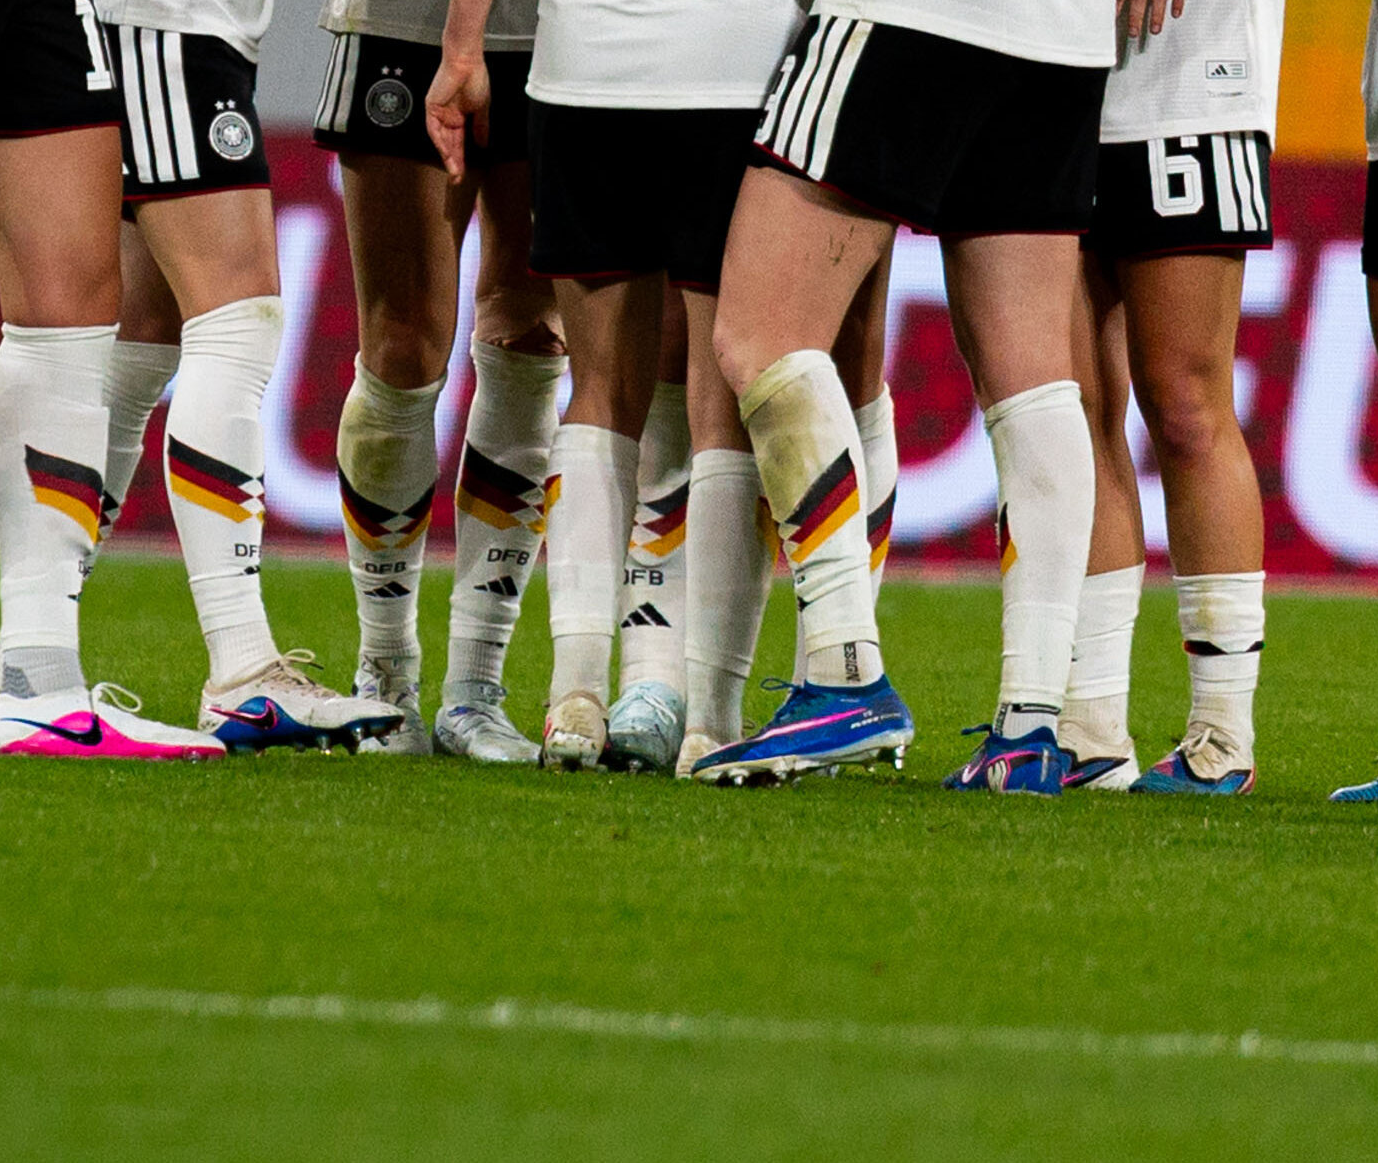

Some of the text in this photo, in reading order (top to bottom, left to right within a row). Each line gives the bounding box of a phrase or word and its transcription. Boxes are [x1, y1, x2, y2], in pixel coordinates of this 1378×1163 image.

[1147, 135, 1204, 217] 6
[234, 543, 262, 558] DF
[487, 548, 530, 566] DFB
[365, 561, 407, 575] DFB
